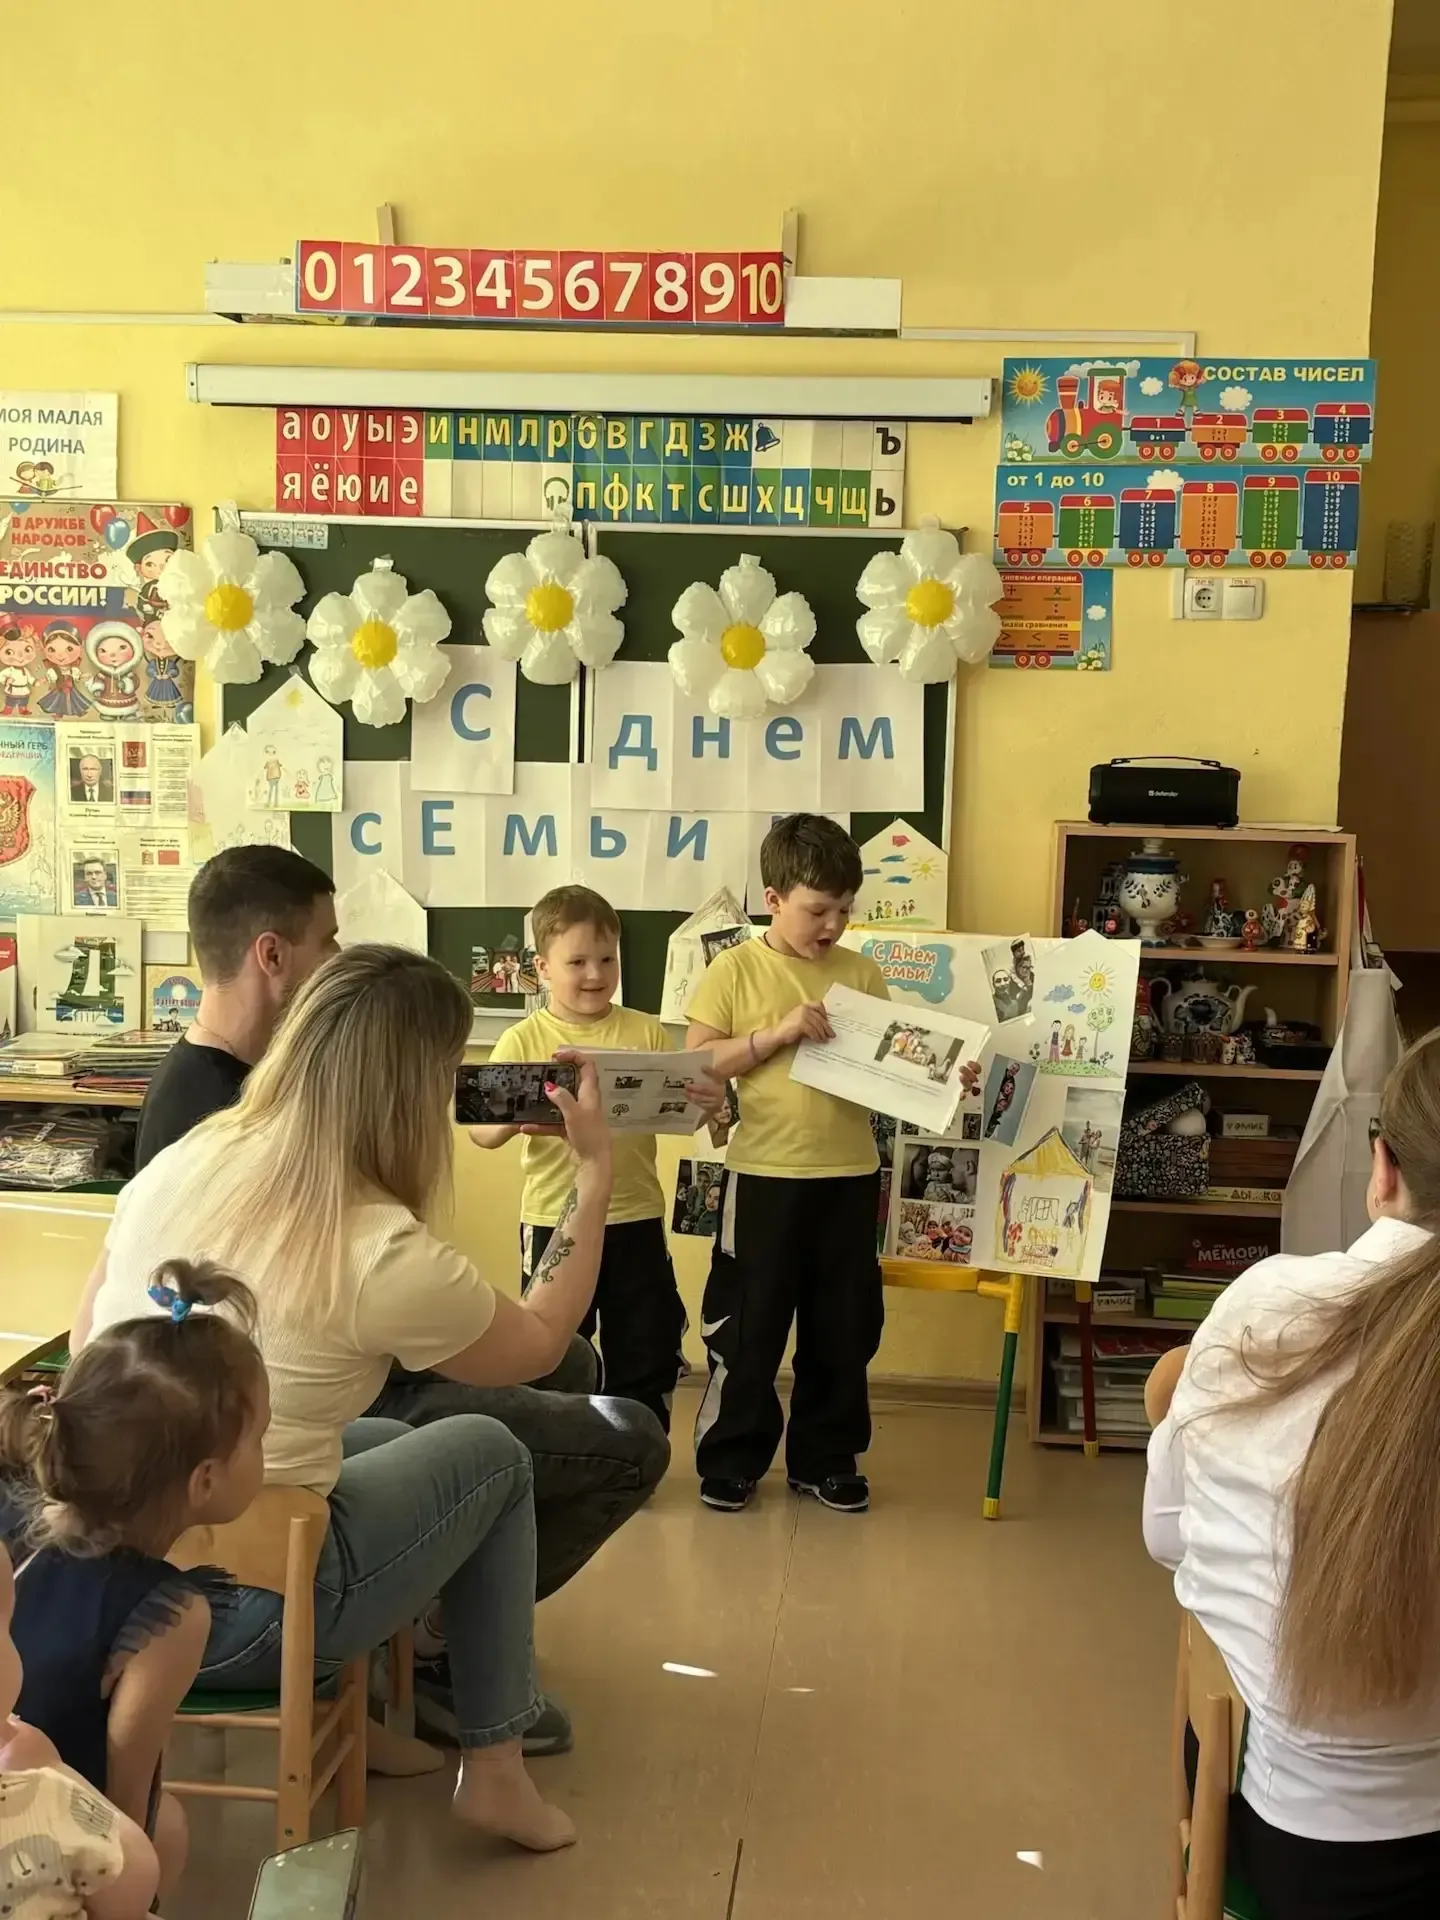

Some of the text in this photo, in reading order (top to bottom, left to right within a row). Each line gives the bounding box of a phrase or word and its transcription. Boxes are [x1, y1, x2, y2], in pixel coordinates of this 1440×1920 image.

[304, 250, 782, 314] 0 1 2 3 4 5 6 7 8 9 10
[1203, 366, 1364, 383] СОСТАВ ЧИСЕЛ
[38, 409, 103, 426] МАЛАЯ
[1277, 410, 1285, 419] 3
[1338, 405, 1347, 415] 4
[1155, 418, 1161, 428] 1
[1216, 414, 1223, 424] 2
[8, 437, 85, 455] РОДИНА
[1007, 472, 1105, 489] от 1 до 10
[1267, 477, 1276, 487] 9
[1326, 471, 1340, 482] 10
[1145, 490, 1153, 500] 7
[1206, 483, 1214, 493] 8
[1023, 503, 1030, 513] 5
[1083, 496, 1091, 506] 6
[12, 516, 86, 531] В ДРУЖБЕ
[11, 534, 94, 547] НАРОДОВ-
[0, 561, 108, 580] ЕДИНСТВО
[0, 584, 108, 608] РОССИИ!
[450, 683, 896, 771] С днем
[27, 741, 49, 751] ГЕРБ
[350, 799, 786, 860] сЕмьи
[872, 943, 938, 967] С Днем
[881, 963, 934, 984] емьи!
[1197, 1245, 1269, 1263] МЕМОРИ
